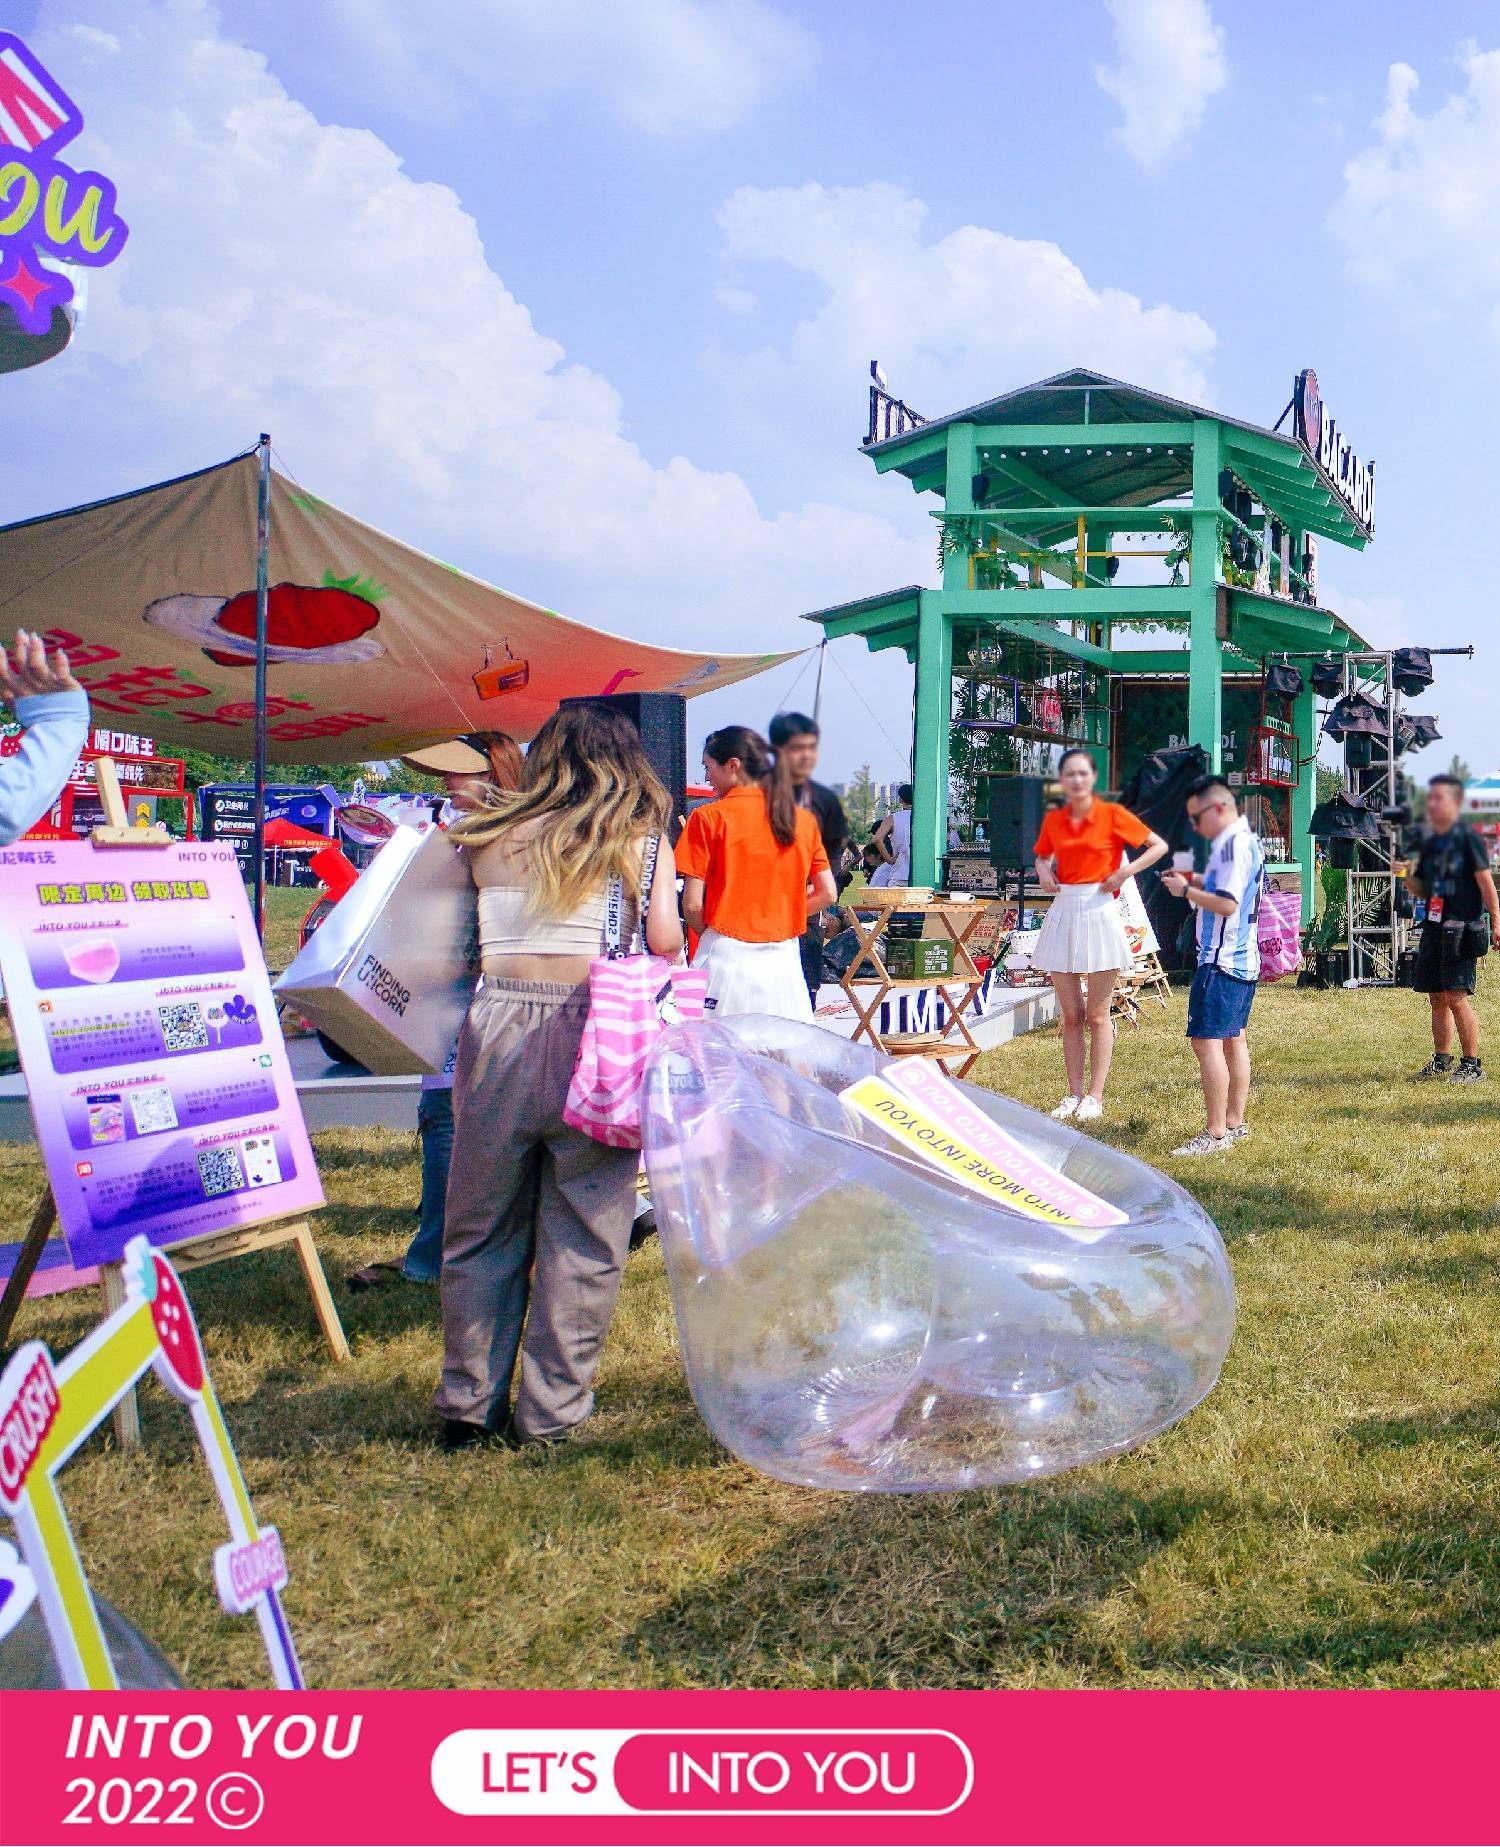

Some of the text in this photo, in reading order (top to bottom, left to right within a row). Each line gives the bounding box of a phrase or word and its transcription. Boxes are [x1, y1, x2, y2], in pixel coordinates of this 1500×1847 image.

[178, 852, 236, 862] INTO YOU
[364, 954, 411, 1004] FINDING
[875, 1100, 917, 1130] YOU
[918, 1128, 967, 1162] INTO
[921, 1086, 1077, 1205] INTO YOU INTO YOU
[963, 1159, 1022, 1195] MORE
[0, 1362, 57, 1489] CRUSH
